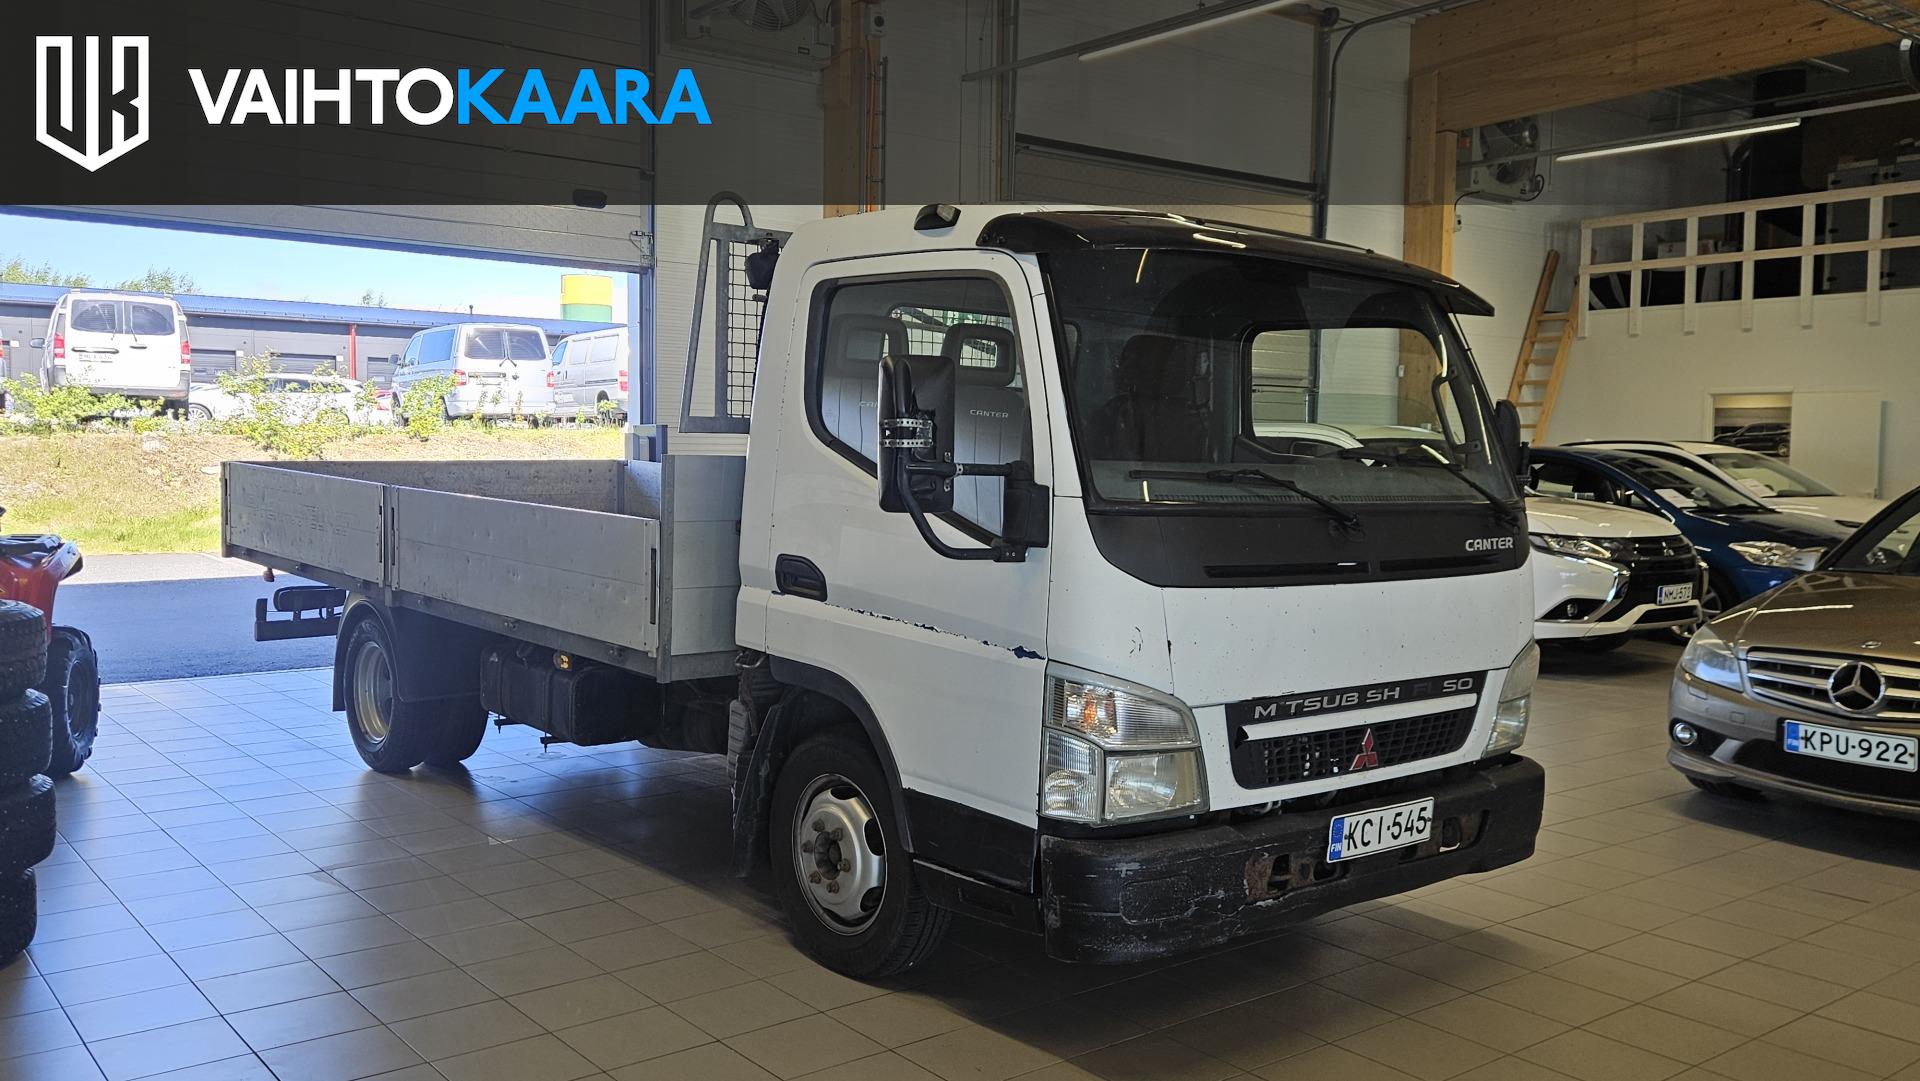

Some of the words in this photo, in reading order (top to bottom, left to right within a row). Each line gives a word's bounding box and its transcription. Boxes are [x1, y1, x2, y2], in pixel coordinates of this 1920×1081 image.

[969, 409, 1009, 418] CANTER
[1465, 537, 1514, 551] CANTER
[1254, 686, 1402, 719] MTSUBSH
[1803, 729, 1908, 764] KPU-922
[1346, 807, 1428, 851] KCI-545
[1331, 843, 1342, 852] FIN
